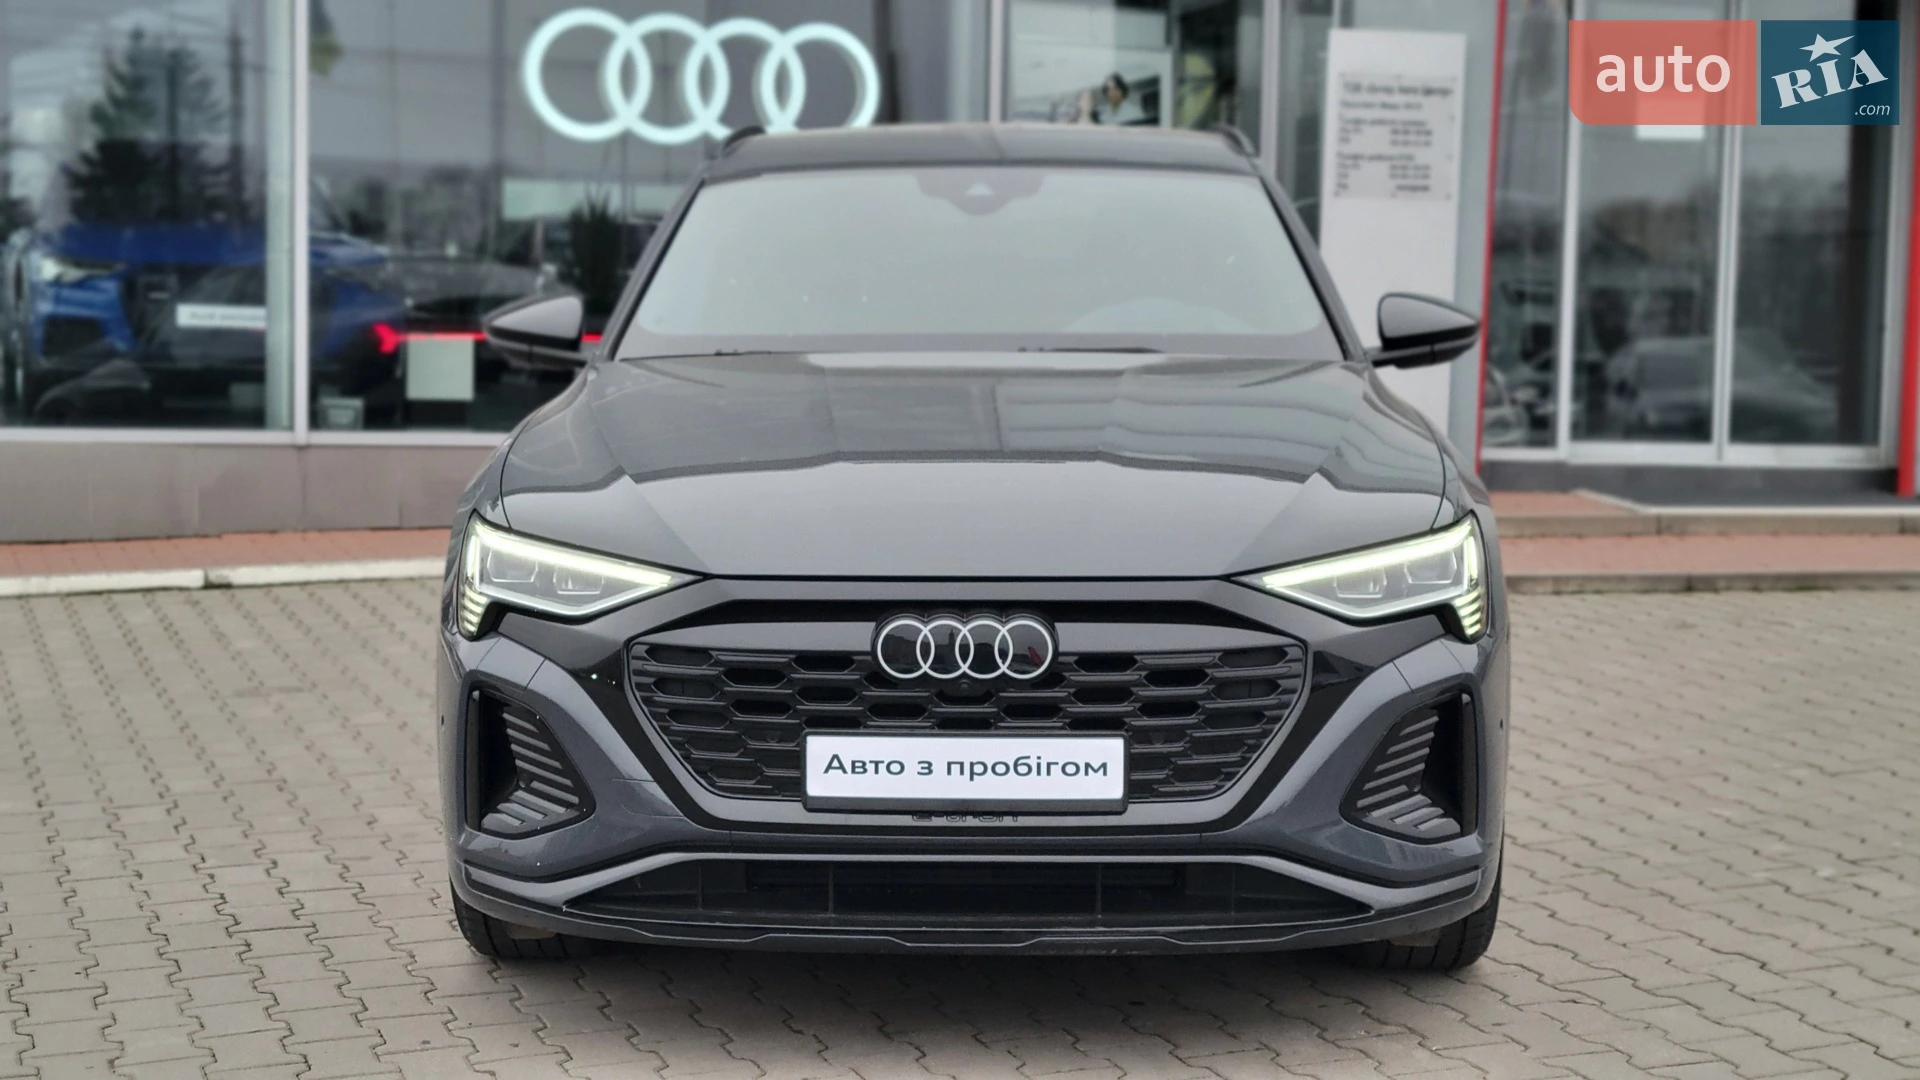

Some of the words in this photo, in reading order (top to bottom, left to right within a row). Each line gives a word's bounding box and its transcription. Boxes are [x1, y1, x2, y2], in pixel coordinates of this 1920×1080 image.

[823, 753, 905, 776] Авто
[916, 760, 934, 776] з
[946, 755, 1108, 782] пробігом
